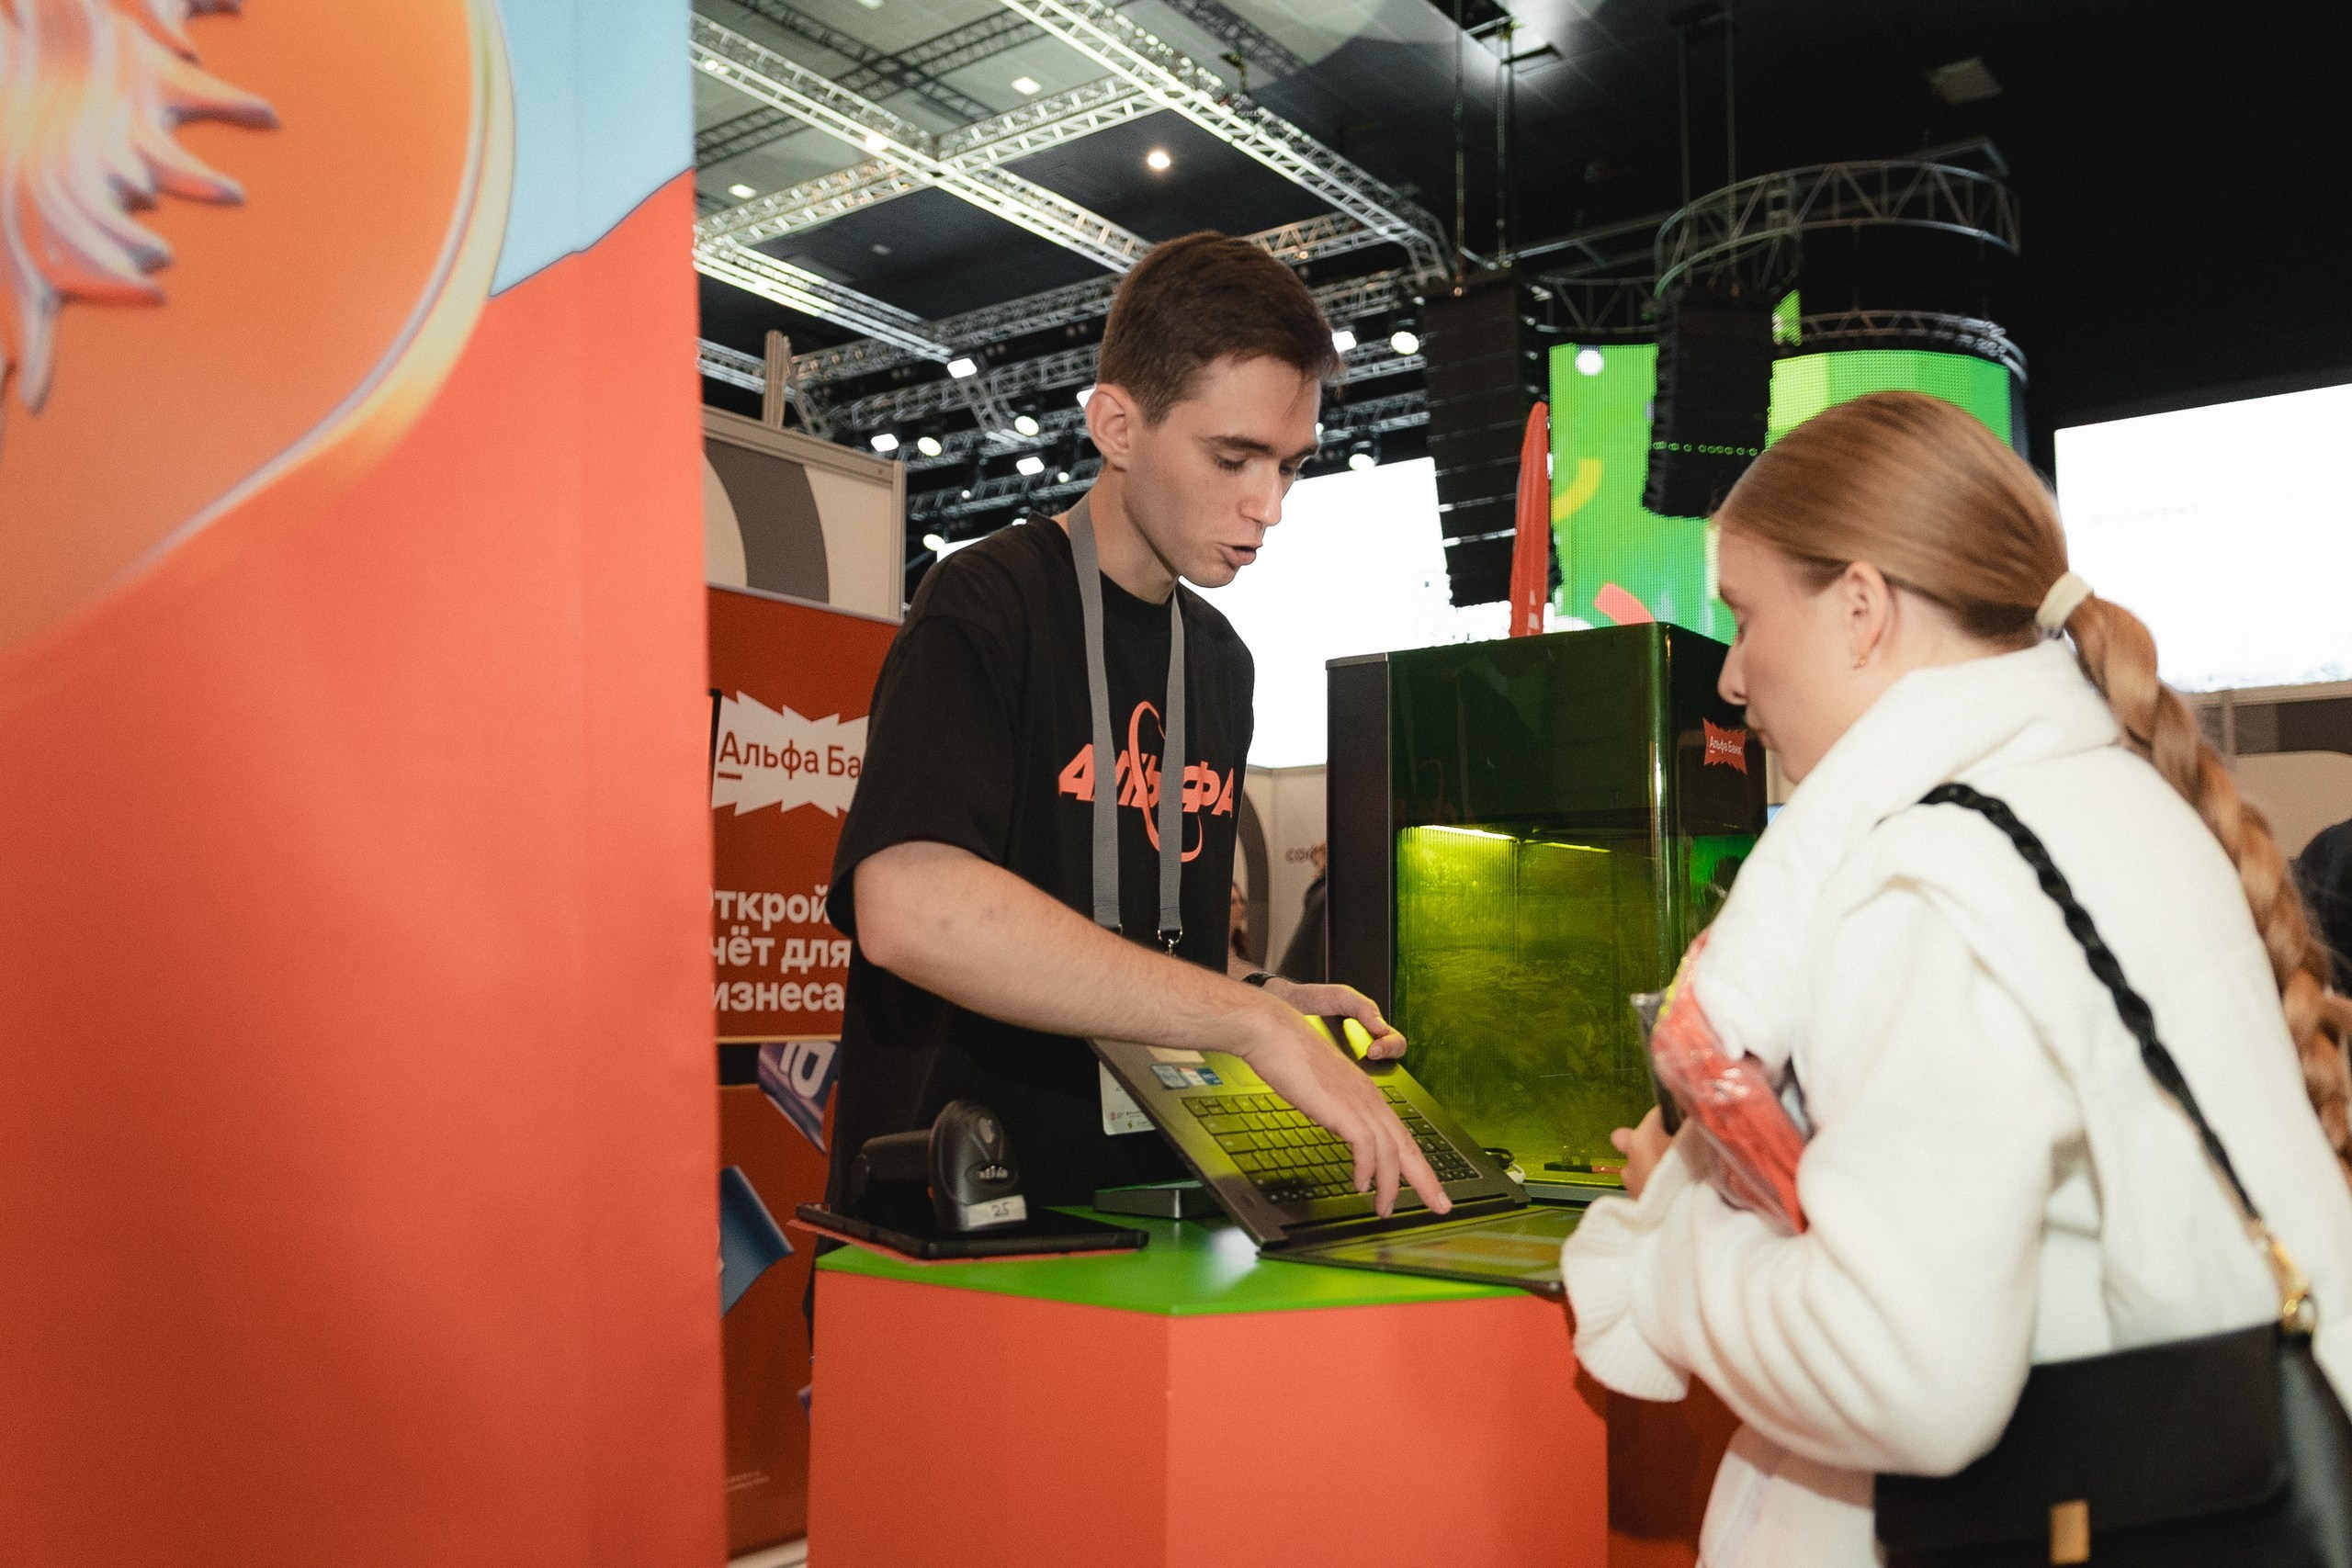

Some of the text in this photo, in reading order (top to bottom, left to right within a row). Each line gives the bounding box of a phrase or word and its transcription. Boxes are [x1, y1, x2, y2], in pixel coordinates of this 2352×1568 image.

[718, 731, 820, 780] Альфа
[708, 884, 831, 931] ткрой
[781, 938, 852, 975] для
